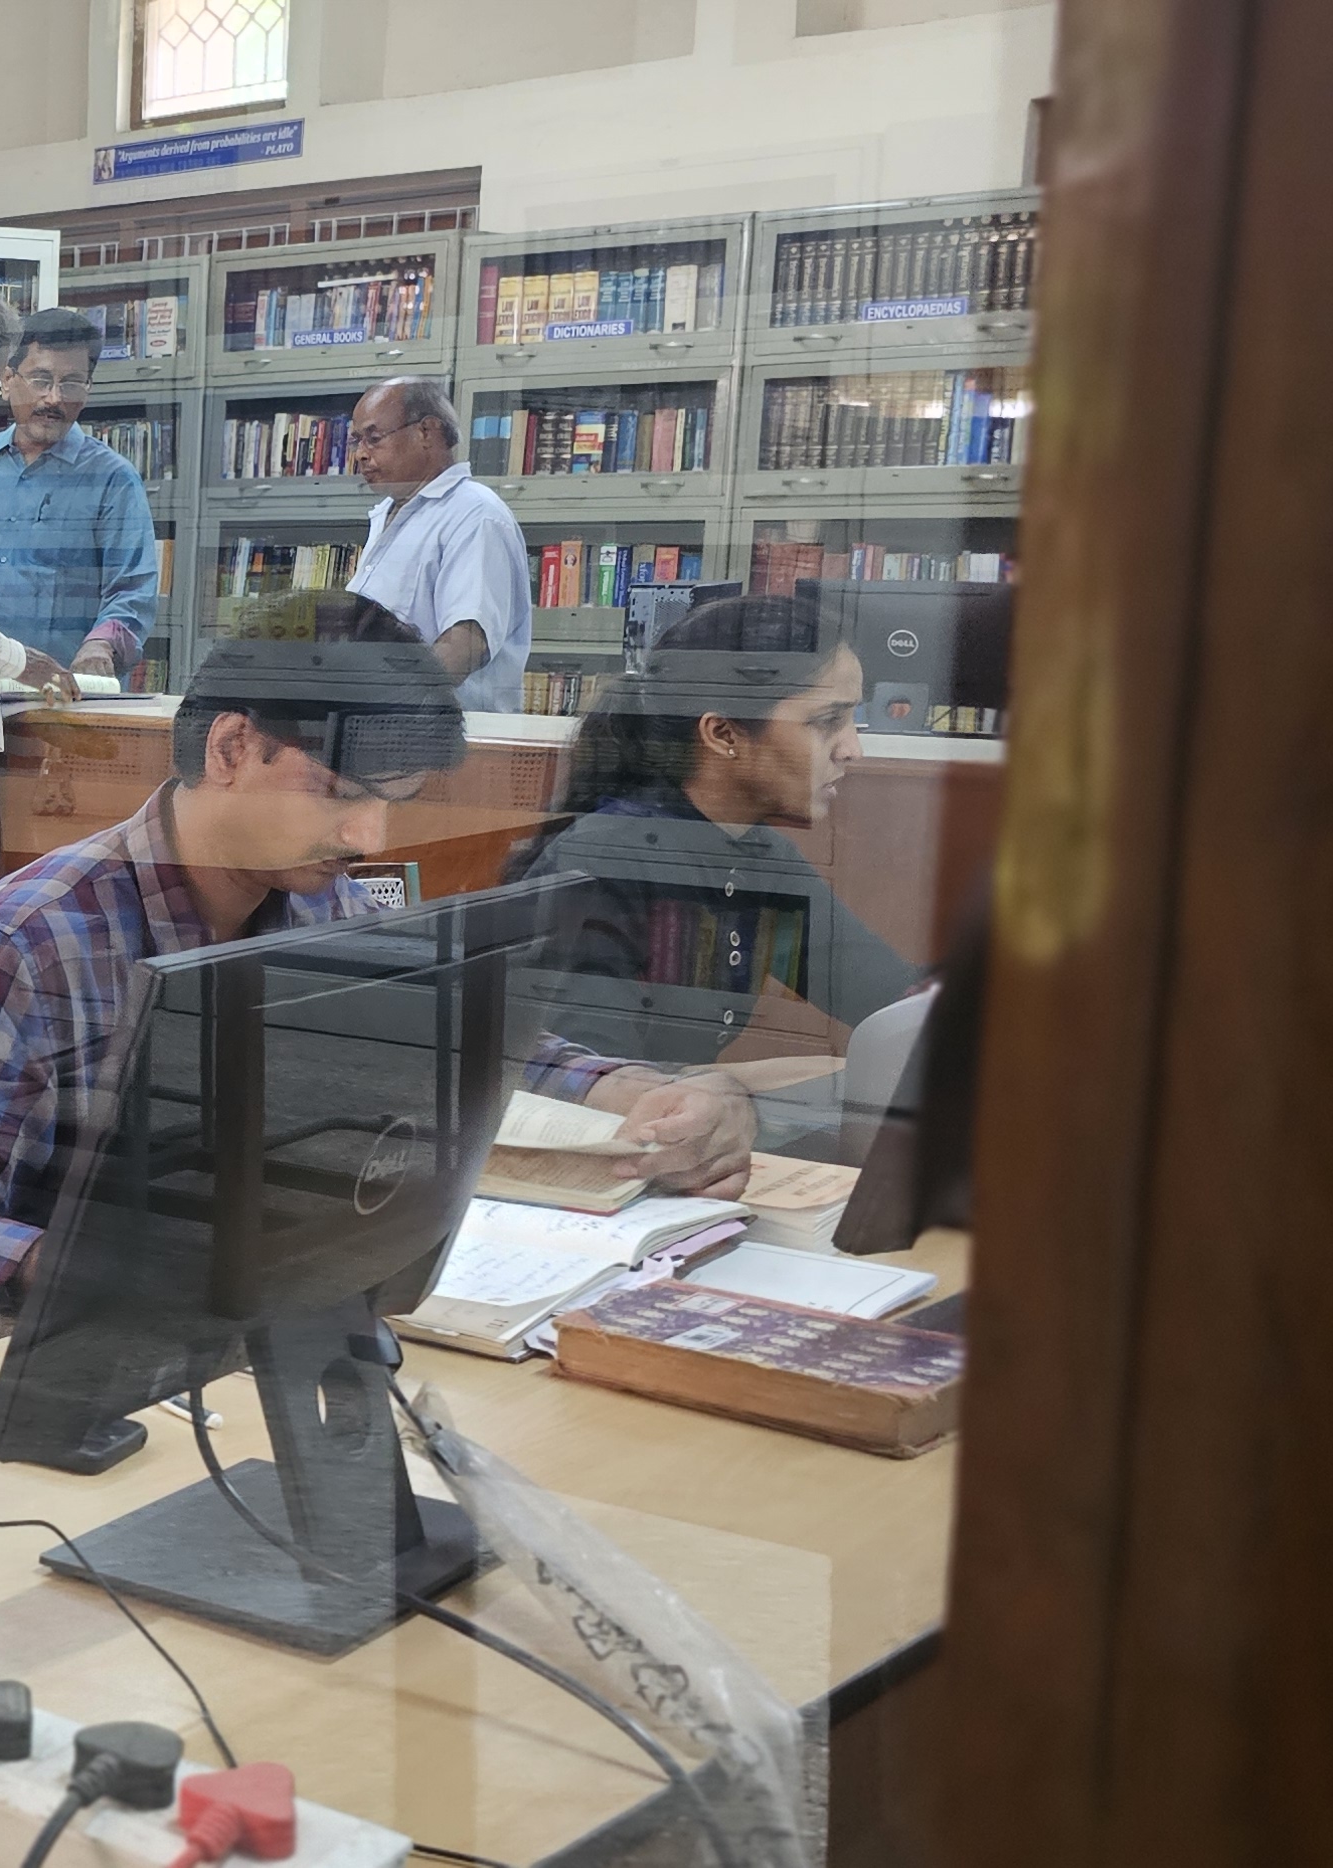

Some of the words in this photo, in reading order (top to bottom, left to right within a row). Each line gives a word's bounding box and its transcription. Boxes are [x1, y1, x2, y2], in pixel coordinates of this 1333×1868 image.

[161, 142, 189, 157] derived
[188, 139, 211, 155] from
[210, 132, 262, 152] probabilities
[262, 131, 277, 142] are
[265, 142, 294, 156] PLATO
[867, 301, 962, 320] ENCYCLOPAEDIAS
[294, 332, 333, 346] GENERAL
[332, 331, 364, 344] BOOKS
[553, 323, 626, 340] DICTIONARIES
[891, 639, 915, 648] DELL
